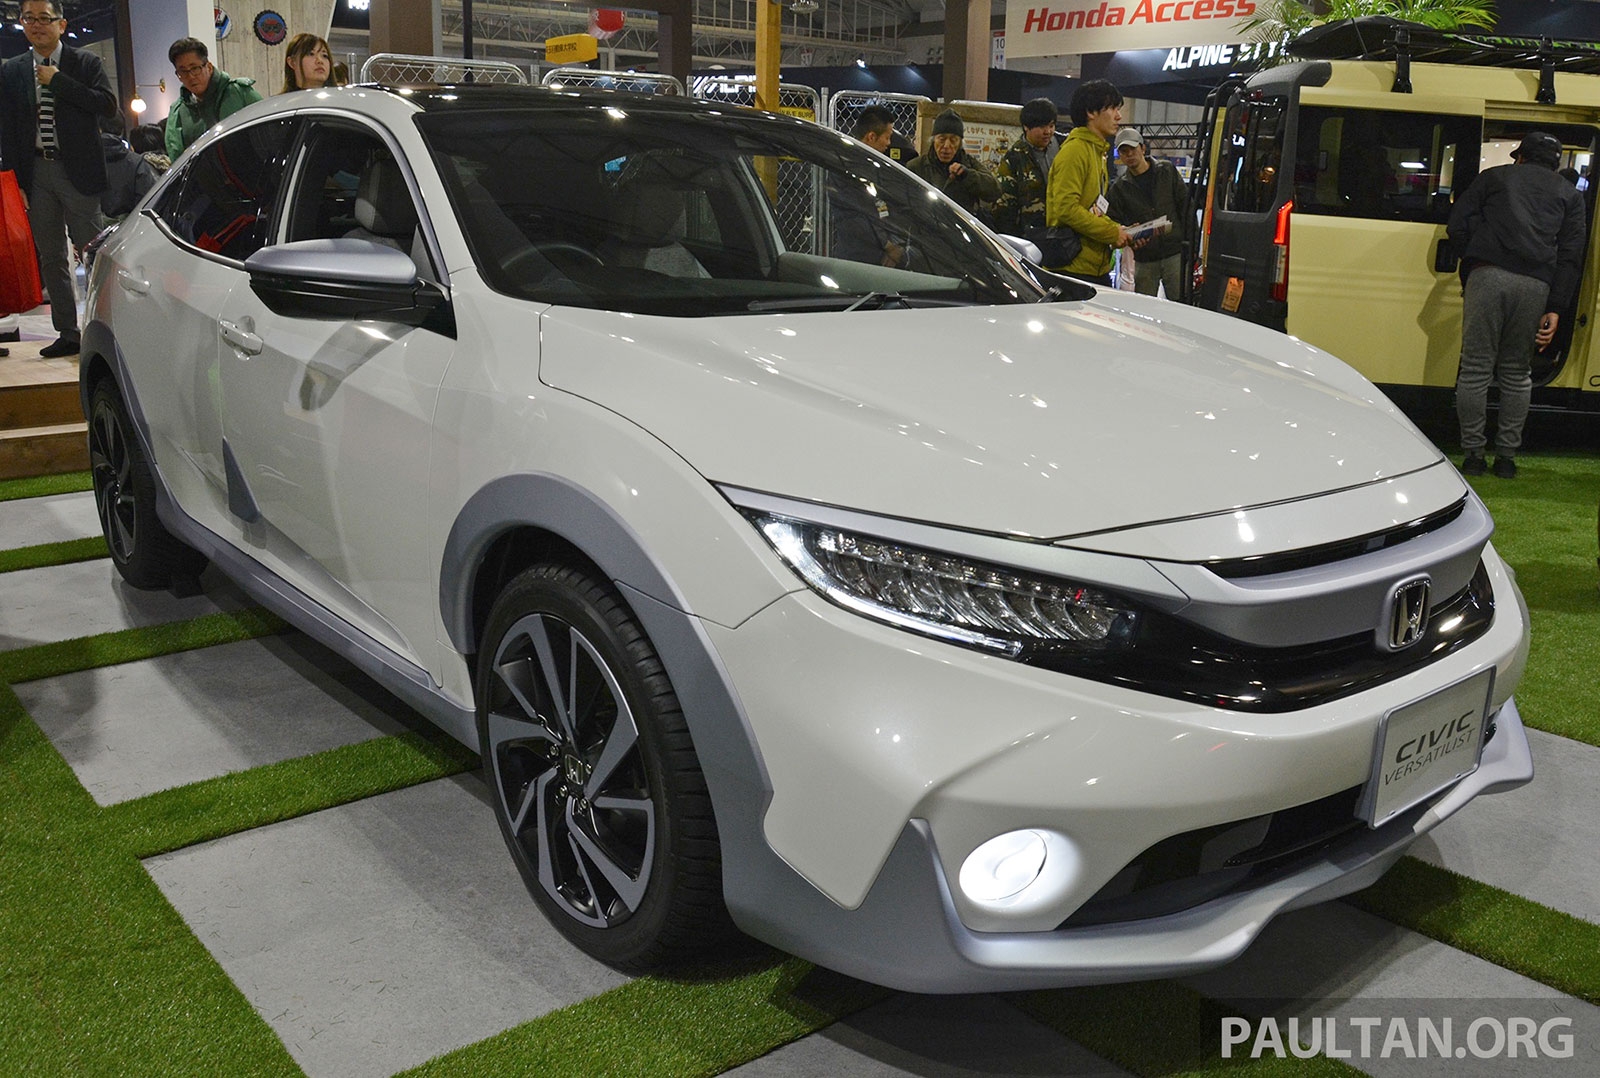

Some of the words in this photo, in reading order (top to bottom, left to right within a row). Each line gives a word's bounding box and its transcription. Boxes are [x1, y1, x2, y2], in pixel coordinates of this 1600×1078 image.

[1023, 2, 1125, 33] Honda
[1128, 0, 1256, 25] Access
[1162, 44, 1233, 71] ALPINE
[1384, 728, 1475, 786] VERSATILIST
[1395, 710, 1475, 764] CIVIC
